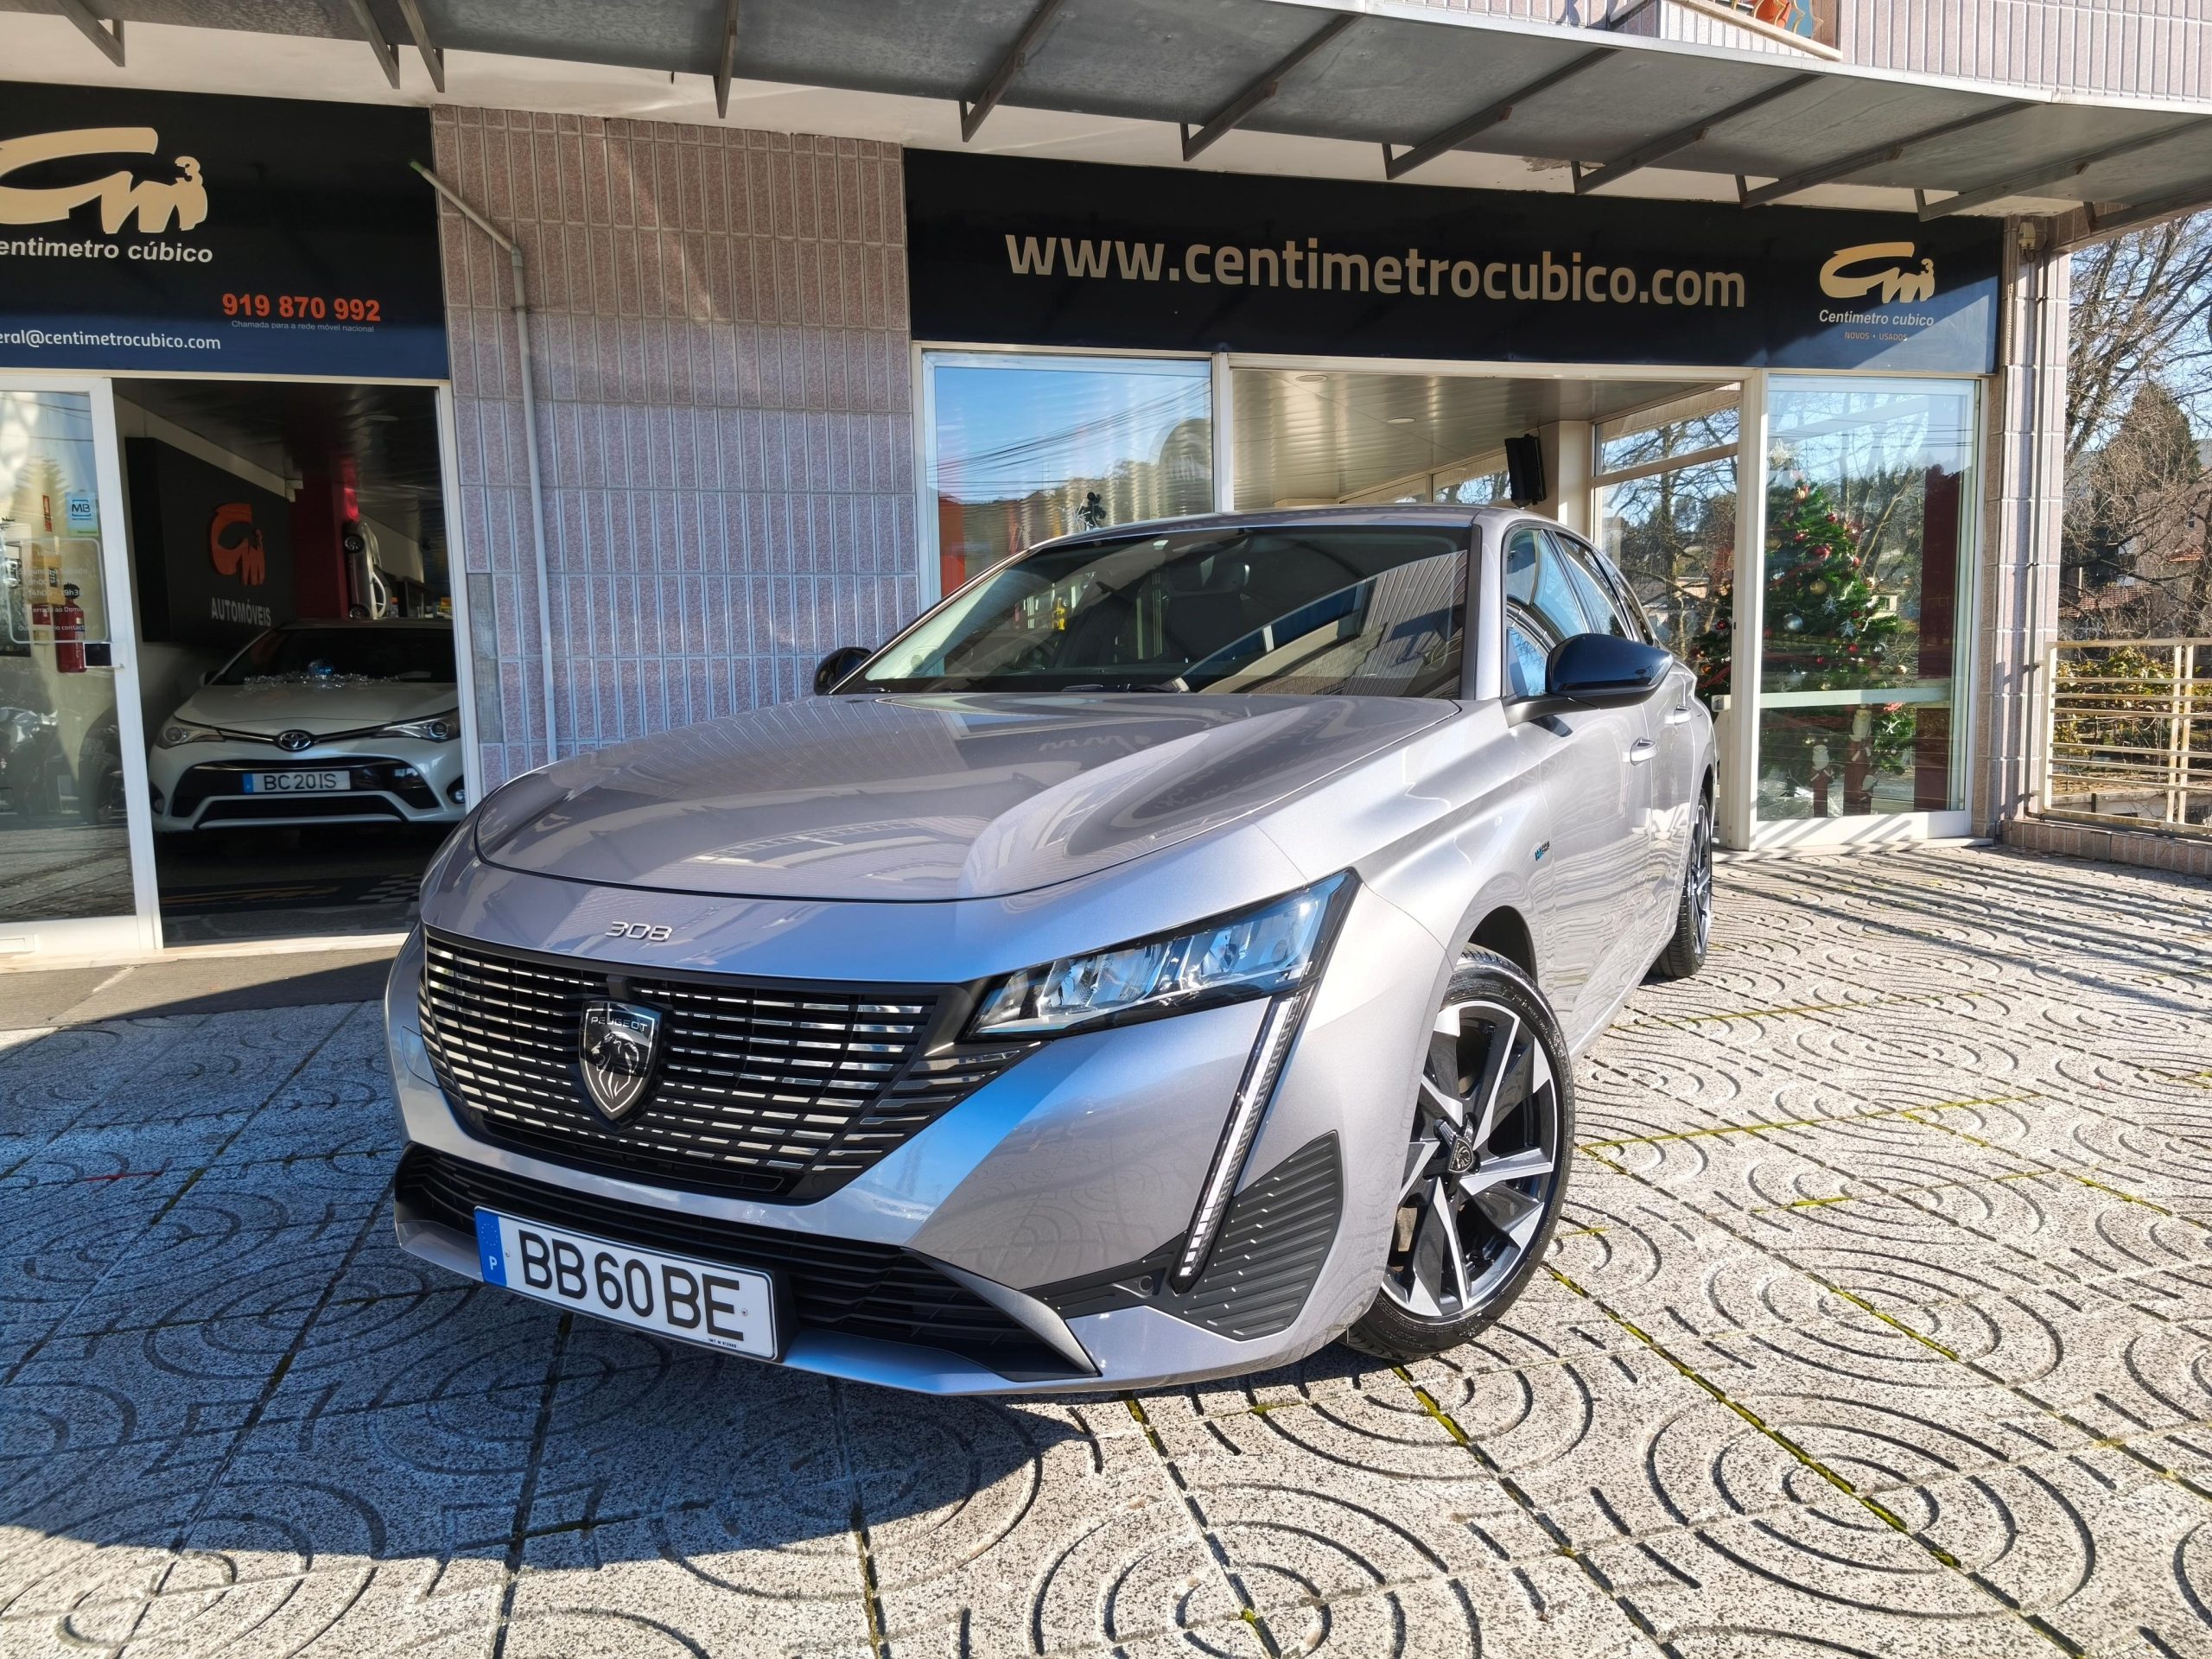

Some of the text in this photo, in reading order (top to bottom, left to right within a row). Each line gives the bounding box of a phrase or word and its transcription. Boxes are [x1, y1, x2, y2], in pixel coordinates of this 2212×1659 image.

[127, 241, 213, 263] cúbico
[1005, 233, 1745, 308] www.centimetrocubico.com
[222, 293, 381, 321] 919 870 992
[232, 320, 270, 329] Chamada
[1819, 309, 1935, 327] Centimetro cubico
[1844, 331, 1908, 341] NOVOS USADOS
[71, 503, 91, 513] MB
[211, 596, 271, 627] AUTOMÓVEIS
[605, 921, 673, 942] 308
[590, 1016, 648, 1032] PEUGEOT
[489, 1255, 498, 1271] P
